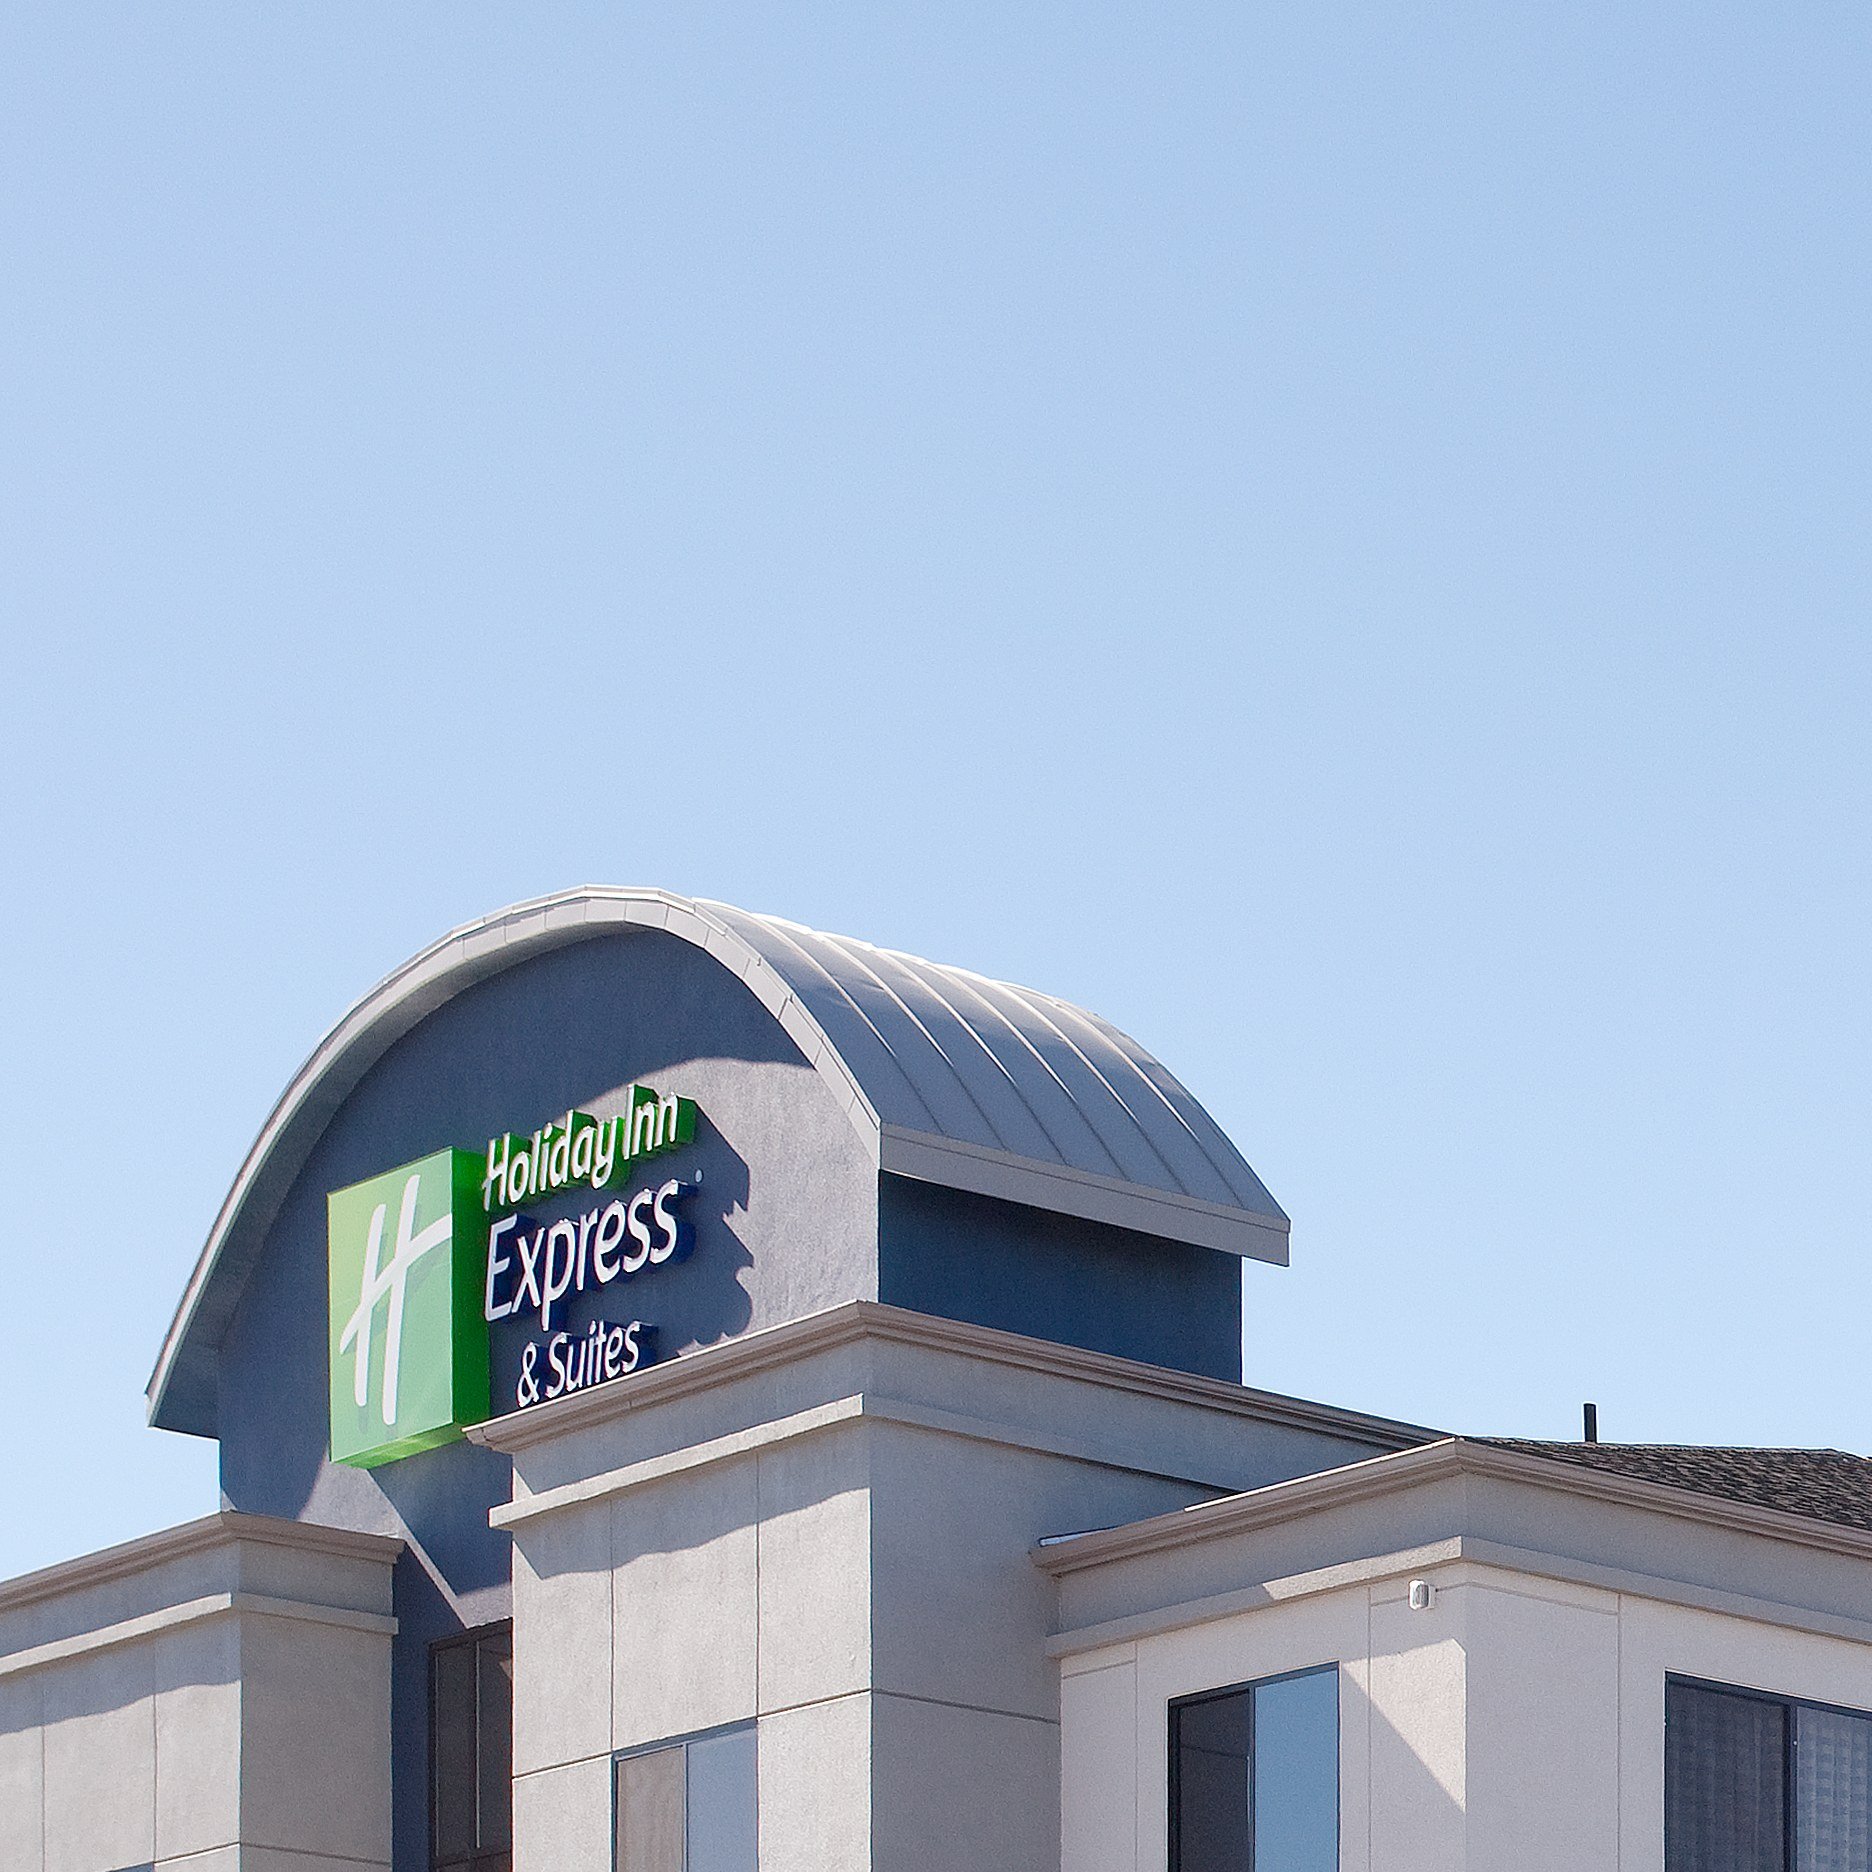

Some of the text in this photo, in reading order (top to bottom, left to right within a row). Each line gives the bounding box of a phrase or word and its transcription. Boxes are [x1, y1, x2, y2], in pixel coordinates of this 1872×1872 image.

[481, 1083, 680, 1212] Holiday Inn
[483, 1178, 678, 1332] Express
[516, 1320, 642, 1408] & Suites
